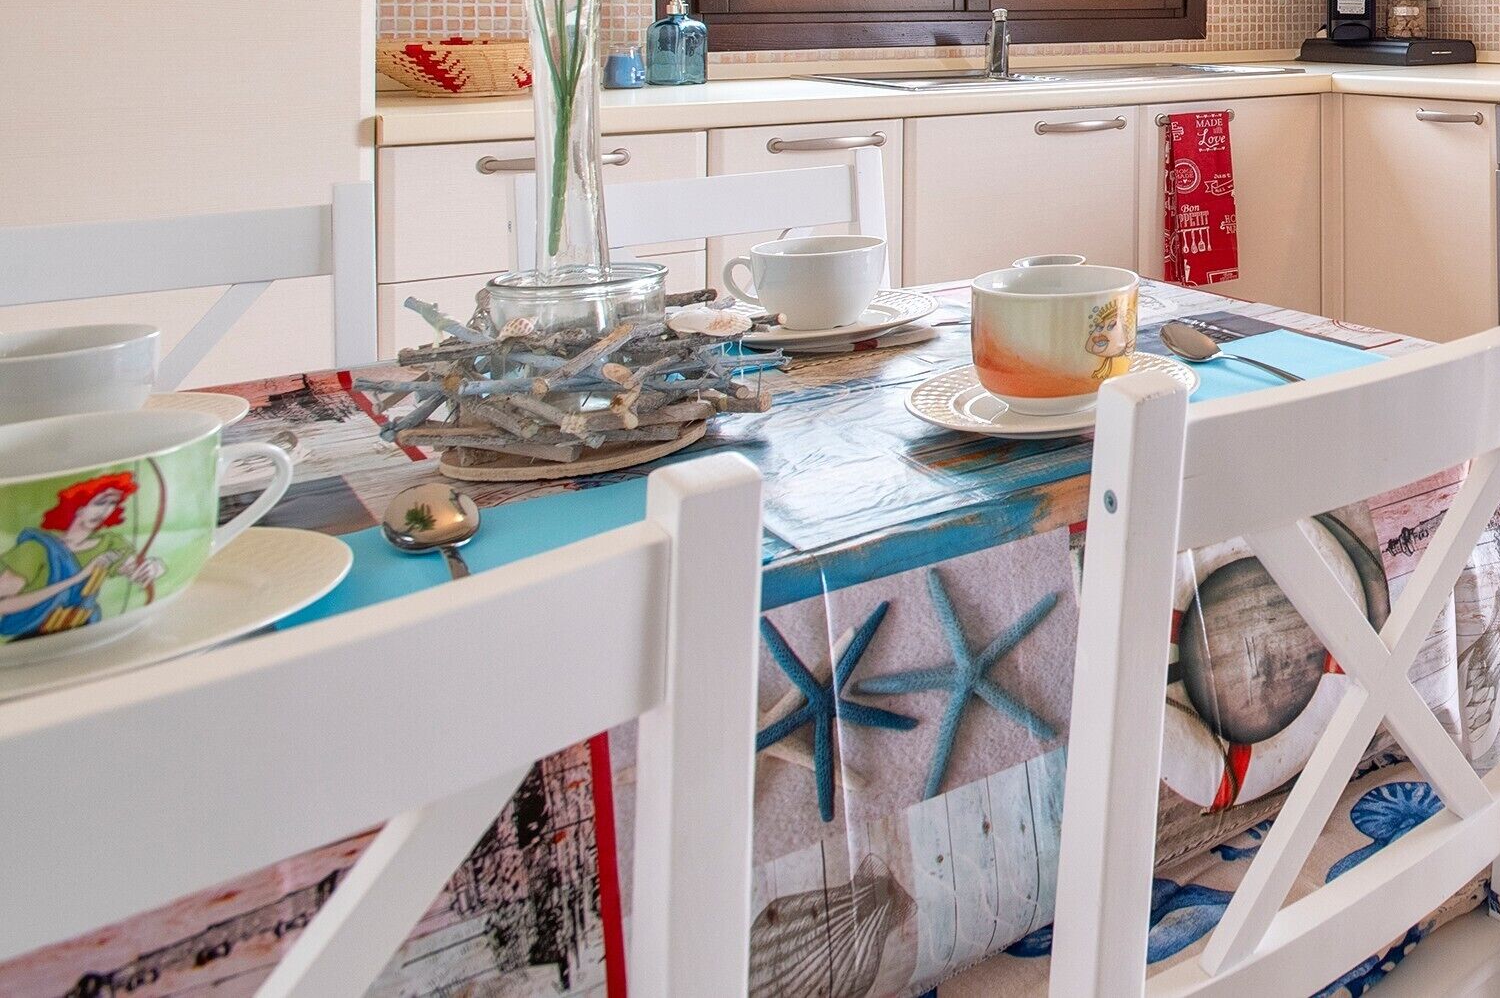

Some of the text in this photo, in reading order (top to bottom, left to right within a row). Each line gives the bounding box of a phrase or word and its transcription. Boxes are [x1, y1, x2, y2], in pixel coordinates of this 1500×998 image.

[1195, 118, 1223, 127] MADE
[1197, 128, 1226, 148] Love
[1180, 203, 1200, 212] Bon
